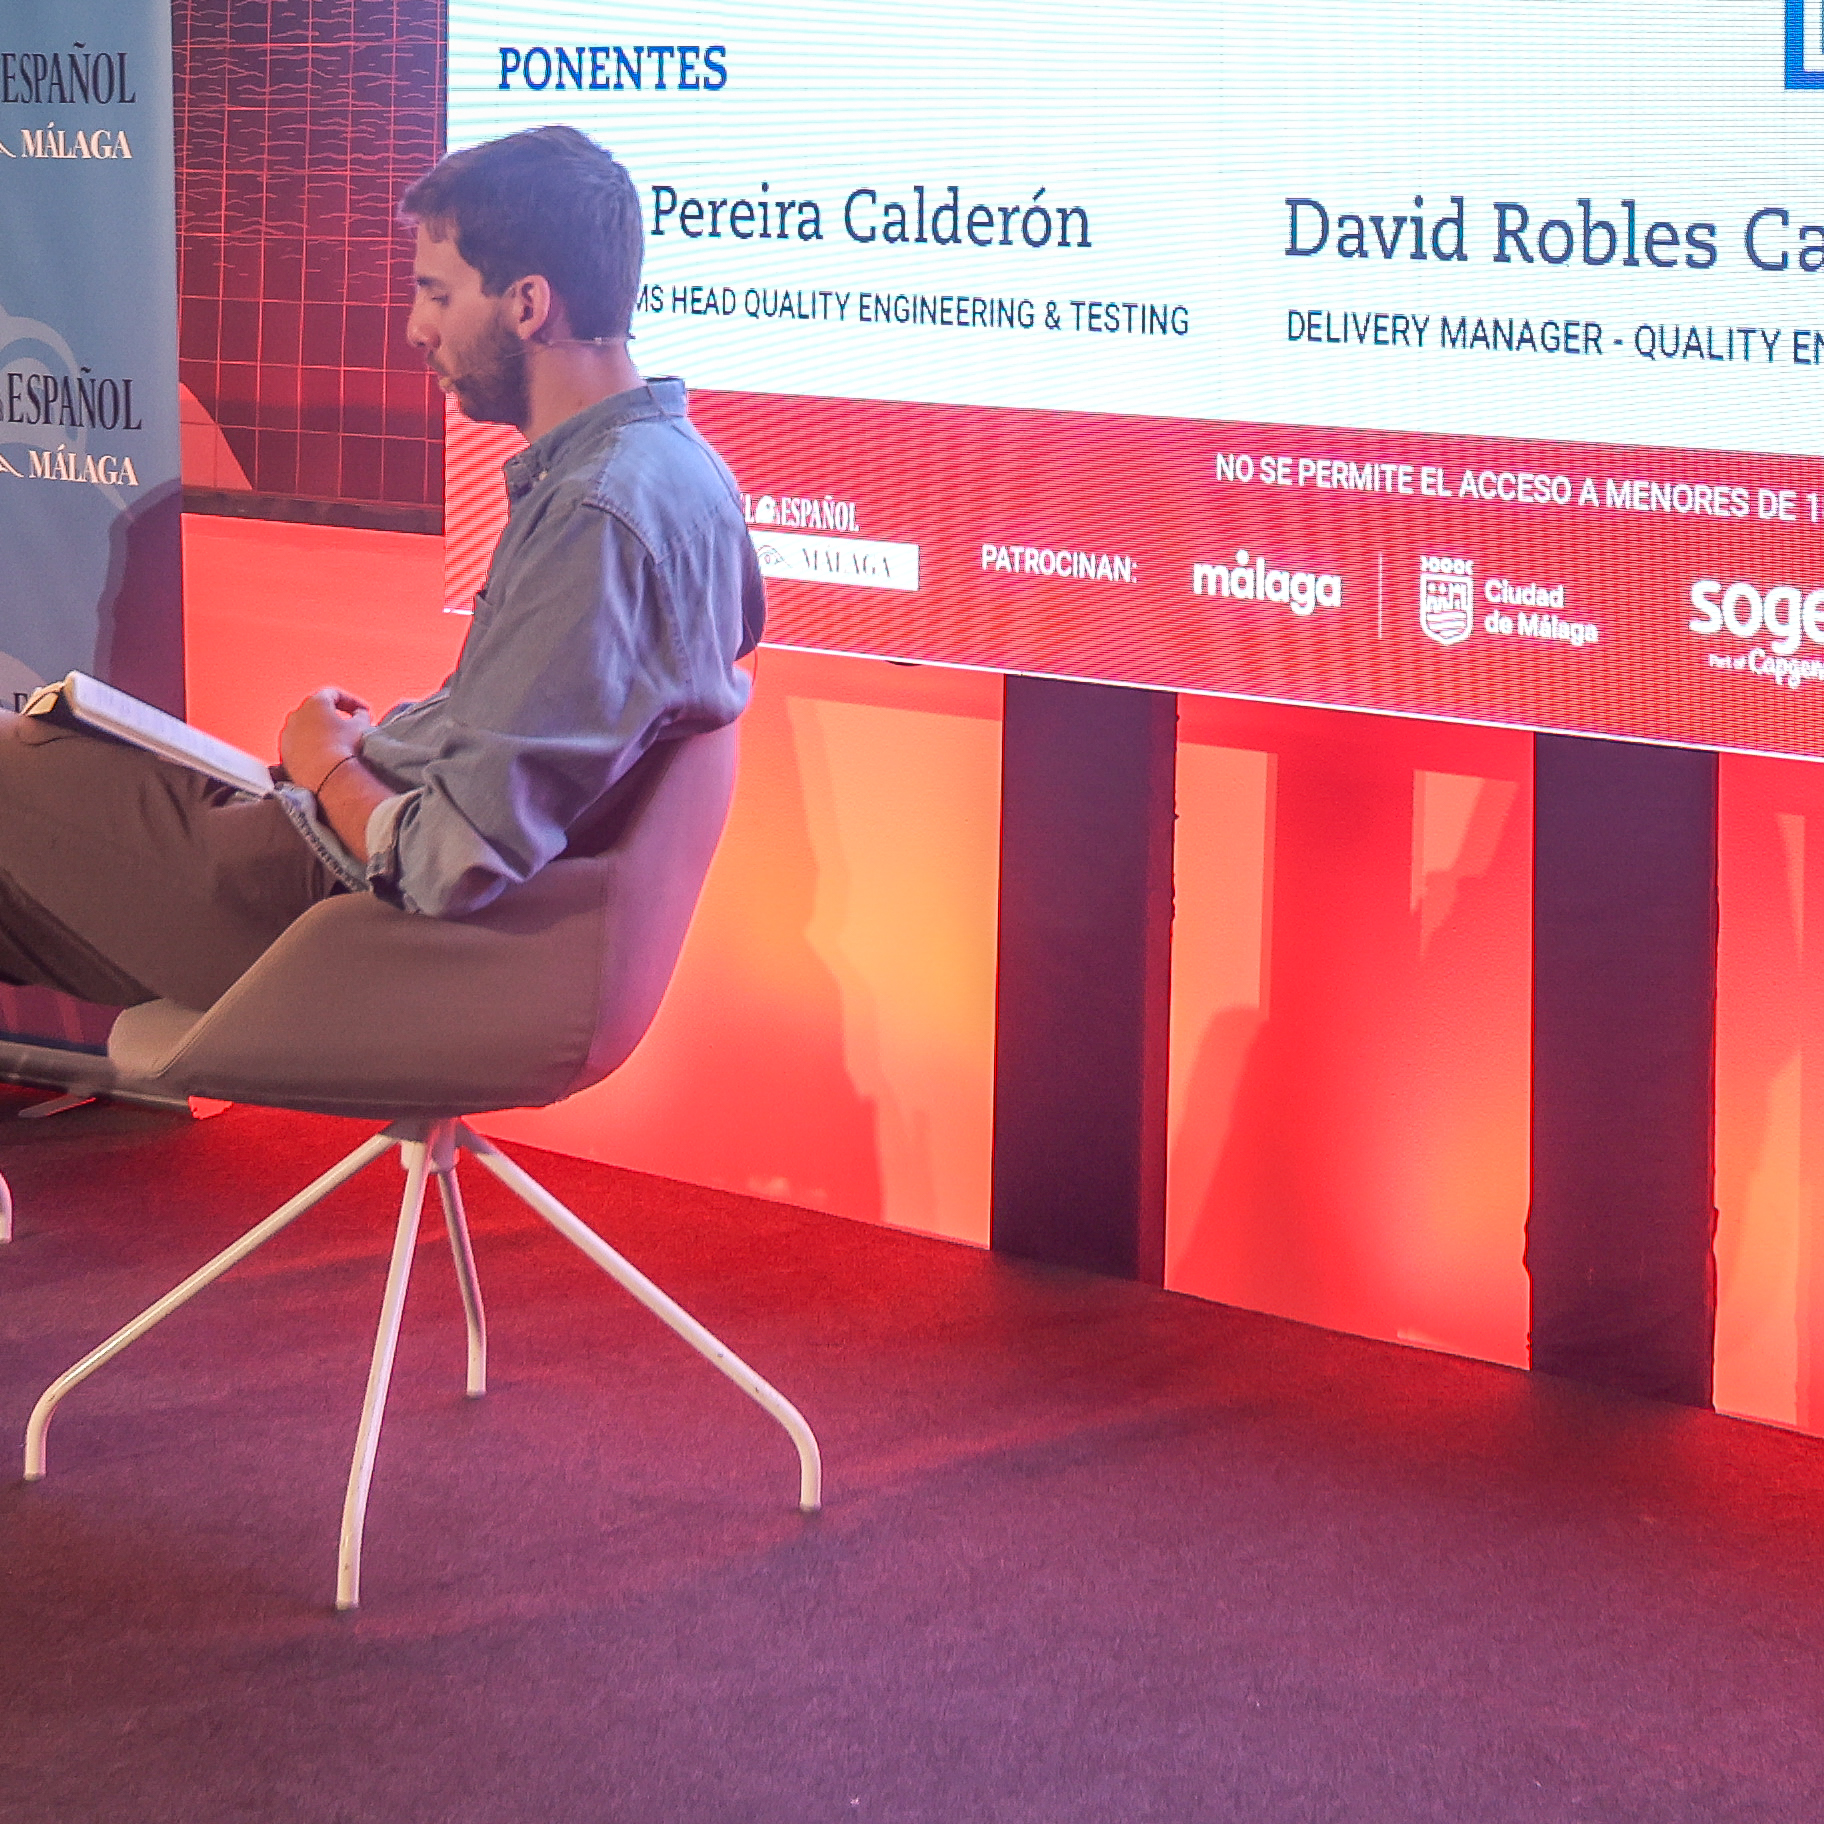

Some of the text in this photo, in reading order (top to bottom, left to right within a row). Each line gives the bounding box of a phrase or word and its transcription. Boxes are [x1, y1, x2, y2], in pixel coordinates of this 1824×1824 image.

[1, 41, 136, 104] ESPAÑOL
[498, 45, 728, 90] PONENTES
[21, 122, 132, 160] MÁLAGA
[650, 182, 1092, 248] Pereira Calderón
[1283, 194, 1468, 263] David
[1493, 199, 1719, 270] Robles
[672, 285, 736, 316] HEAD
[745, 288, 850, 321] QUALITY
[858, 293, 1034, 329] ENGINEERING
[1045, 304, 1061, 331] &
[1070, 301, 1189, 336] TESTING
[1286, 309, 1431, 348] DELIVERY
[1440, 316, 1603, 355] MANAGER
[1634, 323, 1780, 364] QUALITY
[8, 366, 142, 430] ESPAÑOL
[29, 444, 139, 486] MÁLAGA
[1216, 452, 1254, 483] NO
[1259, 456, 1293, 486] SE
[1297, 459, 1414, 496] PERMITE
[1419, 467, 1454, 497] EL
[1458, 470, 1572, 505] ACCESO
[1578, 476, 1601, 506] A
[1606, 479, 1750, 518] MENORES
[1757, 489, 1798, 521] DE
[782, 495, 860, 532] ESPAÑOL
[982, 544, 1137, 583] PATROCINAN:
[1483, 579, 1565, 608] Ciudad
[1484, 610, 1599, 646] de Málaga
